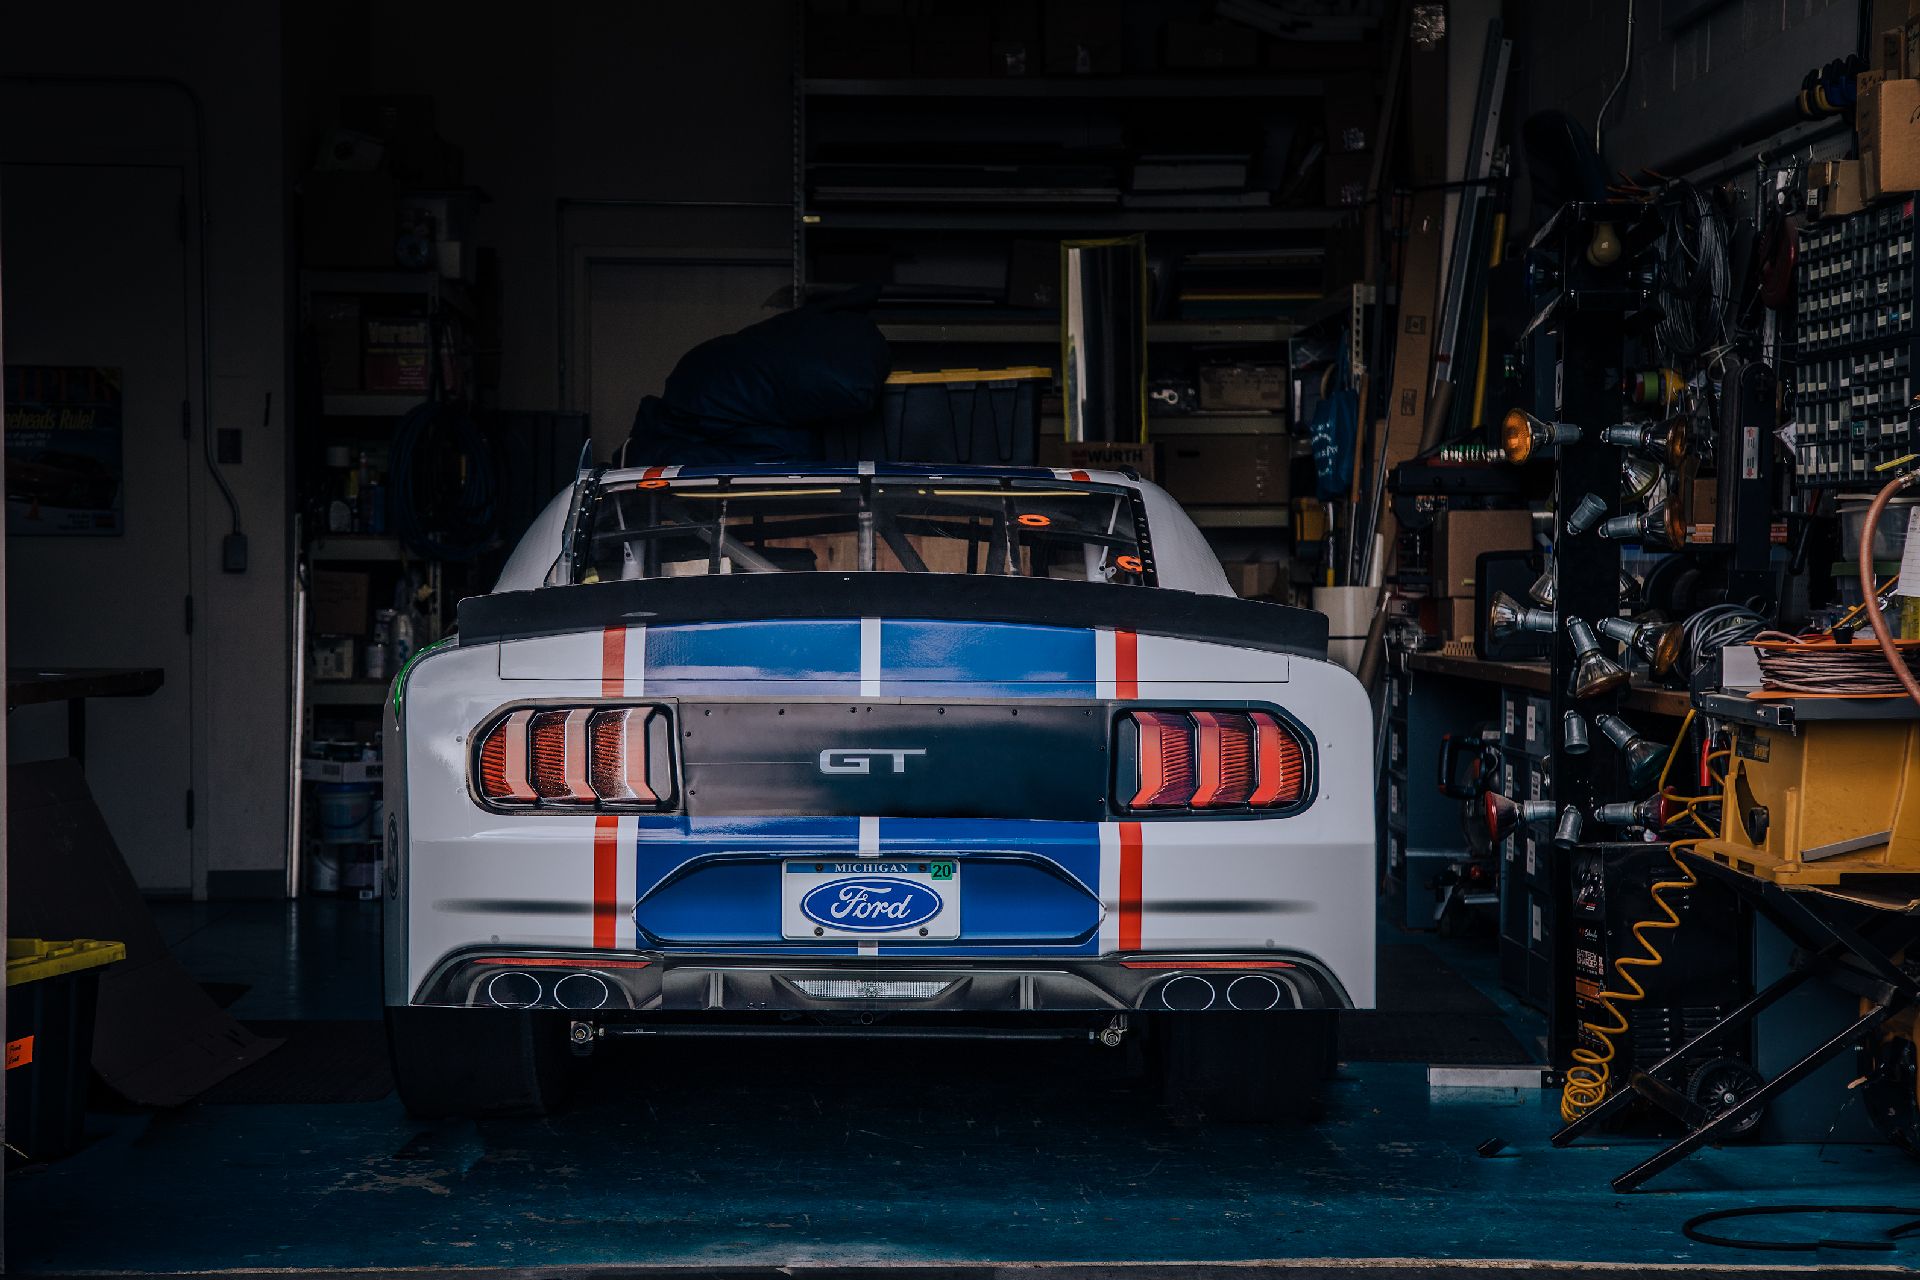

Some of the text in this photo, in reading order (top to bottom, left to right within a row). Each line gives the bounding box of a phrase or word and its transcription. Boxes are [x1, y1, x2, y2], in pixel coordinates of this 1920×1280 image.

[58, 407, 96, 431] Rule!
[819, 748, 927, 775] GT
[834, 863, 909, 873] MICHIGAN
[932, 864, 952, 878] 20
[830, 885, 914, 919] Ford
